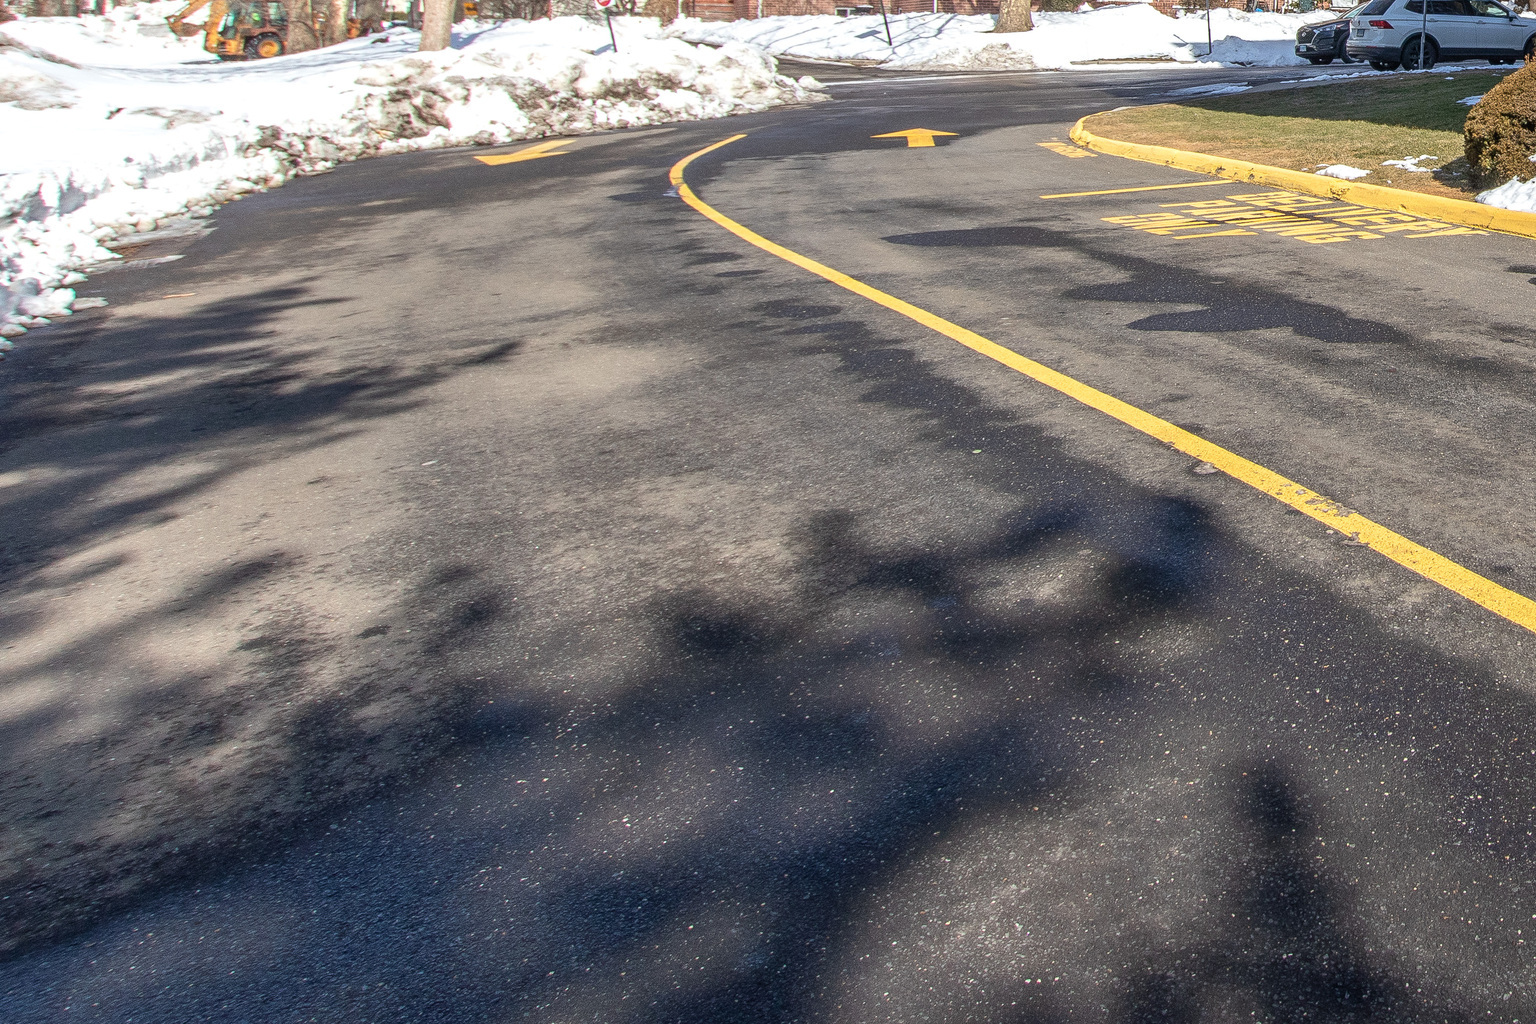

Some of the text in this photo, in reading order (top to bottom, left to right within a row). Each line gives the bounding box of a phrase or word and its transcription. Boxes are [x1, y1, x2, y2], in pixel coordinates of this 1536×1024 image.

[1100, 212, 1259, 240] ONLY
[1158, 199, 1385, 244] PARKING
[1225, 191, 1490, 238] DELIVERY
